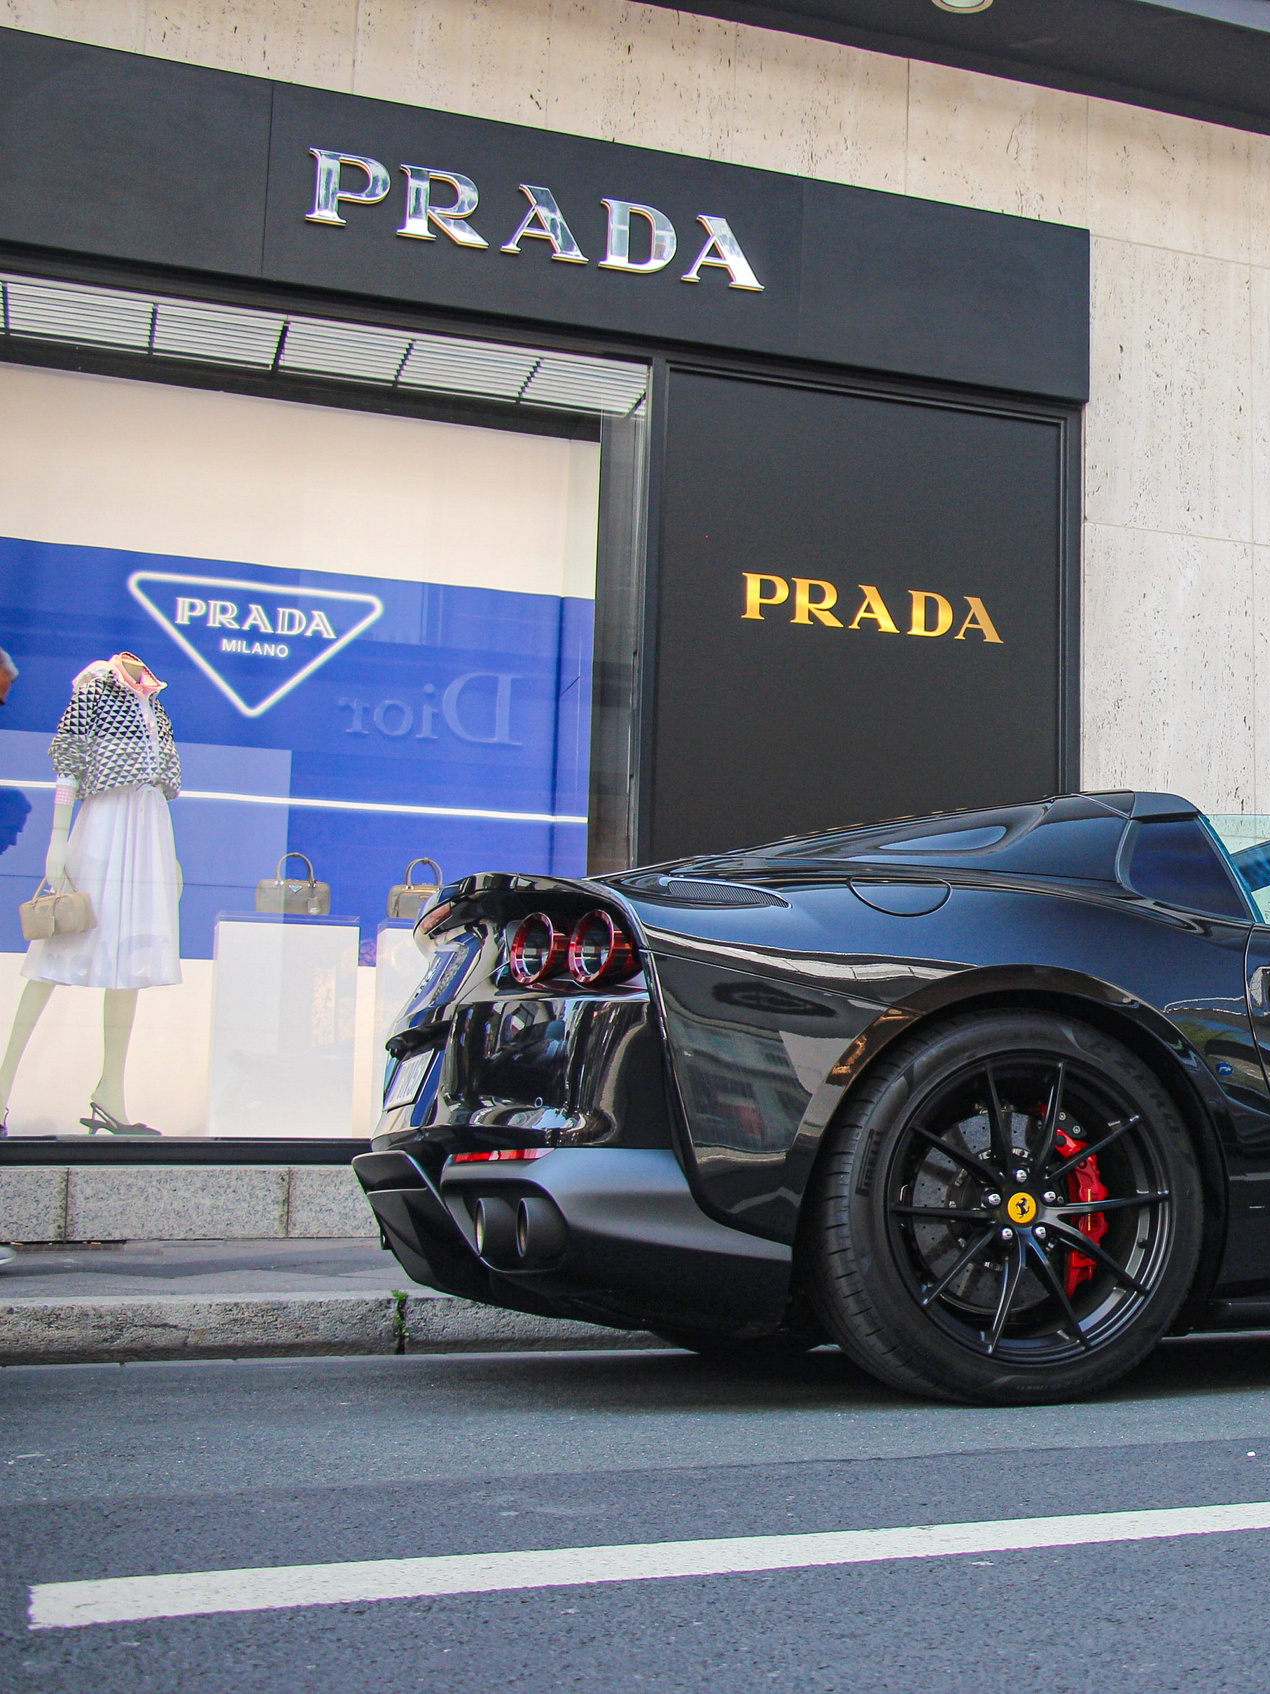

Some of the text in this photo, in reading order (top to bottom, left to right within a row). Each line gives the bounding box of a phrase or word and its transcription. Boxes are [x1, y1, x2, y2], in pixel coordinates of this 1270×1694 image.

[304, 147, 765, 292] PRADA
[174, 597, 337, 640] PRADA
[741, 572, 1005, 645] PRADA
[221, 638, 289, 659] MILANO
